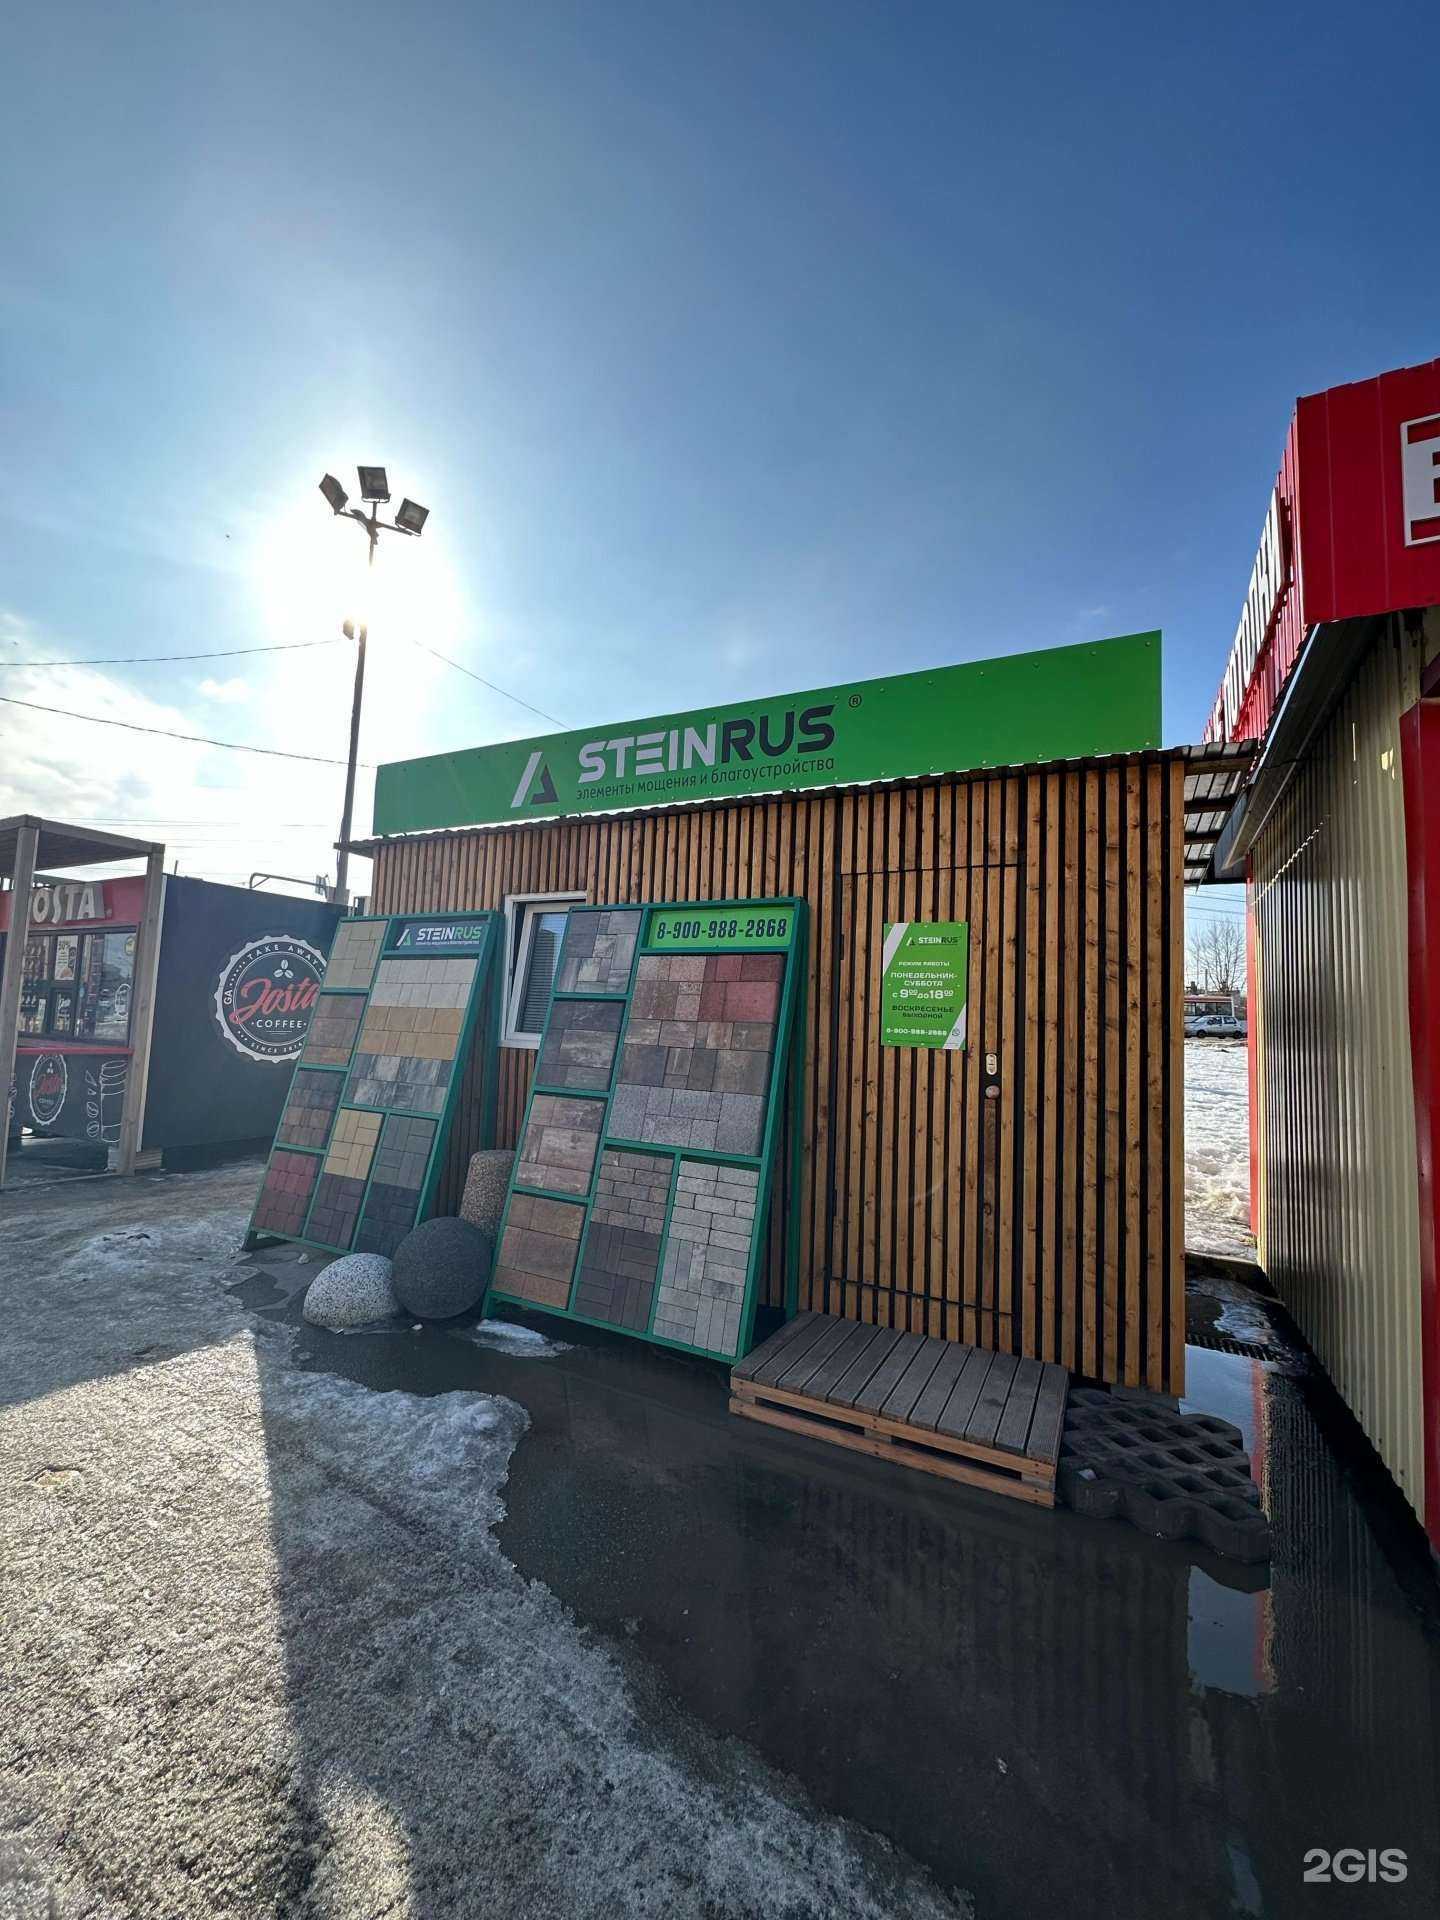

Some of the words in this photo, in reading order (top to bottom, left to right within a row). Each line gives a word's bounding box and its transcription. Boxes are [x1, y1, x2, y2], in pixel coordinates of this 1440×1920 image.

[1222, 486, 1285, 743] ПОТОЛКИ
[577, 704, 836, 784] STEINRUS
[576, 781, 634, 800] элементы
[636, 772, 697, 795] мощения
[699, 773, 708, 786] и
[710, 756, 835, 788] благоустройства
[31, 881, 104, 924] OSTA
[416, 926, 483, 941] STEINRUS
[656, 918, 787, 939] 8-900-988-2868
[918, 936, 960, 945] STEINRUS
[247, 944, 280, 961] TAKE
[287, 944, 319, 966] AWAY
[903, 980, 943, 988] СУББОТА
[891, 1004, 954, 1013] ВОСКРЕСЕНЬЕ
[256, 1019, 303, 1029] COFFEE
